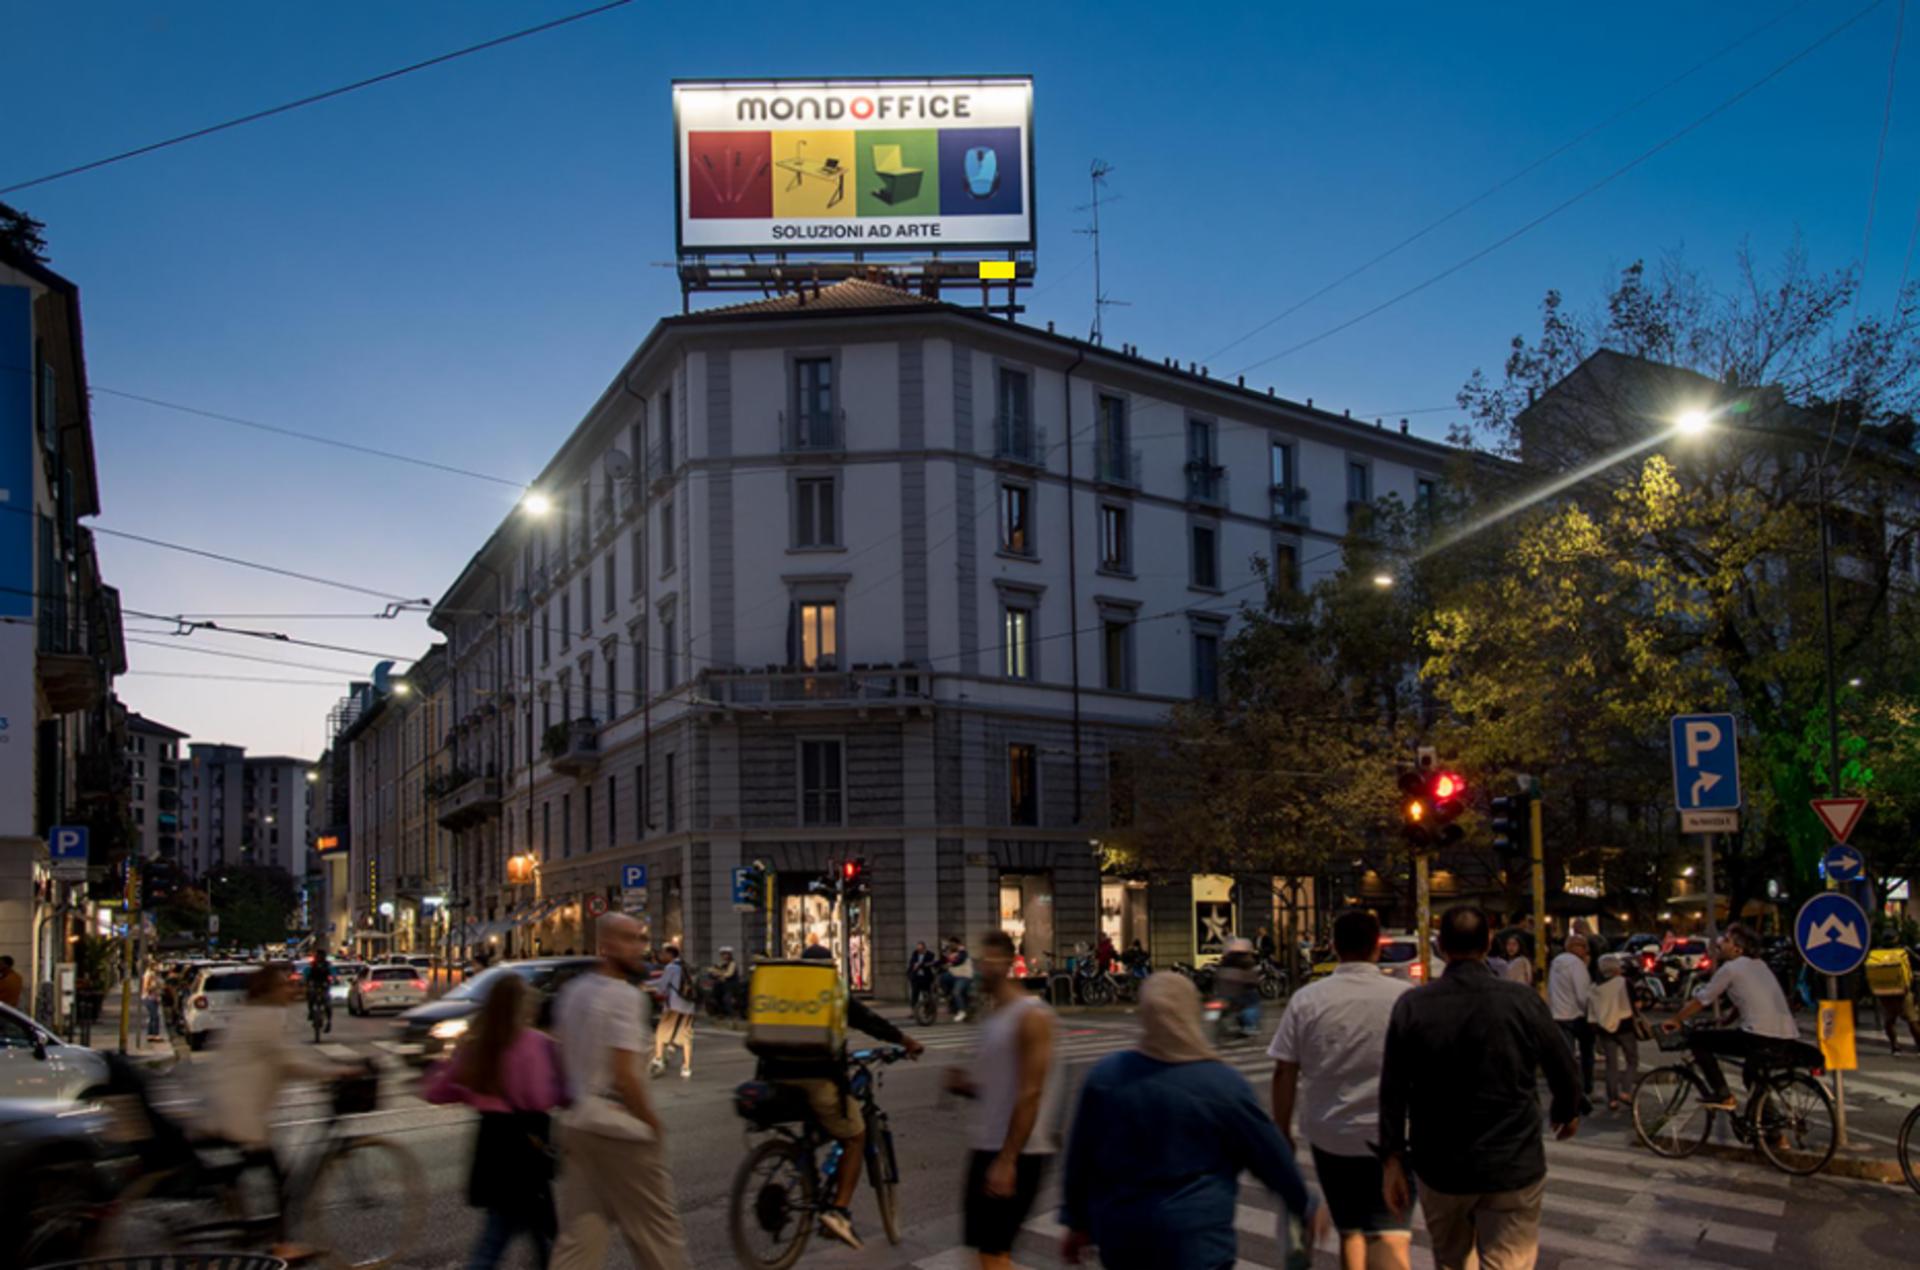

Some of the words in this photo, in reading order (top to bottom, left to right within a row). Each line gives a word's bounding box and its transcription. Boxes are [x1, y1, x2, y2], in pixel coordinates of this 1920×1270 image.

[772, 224, 863, 240] SOLUZIONI
[867, 224, 892, 238] AD
[895, 223, 942, 238] ARTE
[1685, 722, 1721, 767] P
[58, 831, 79, 854] P
[627, 867, 642, 886] P
